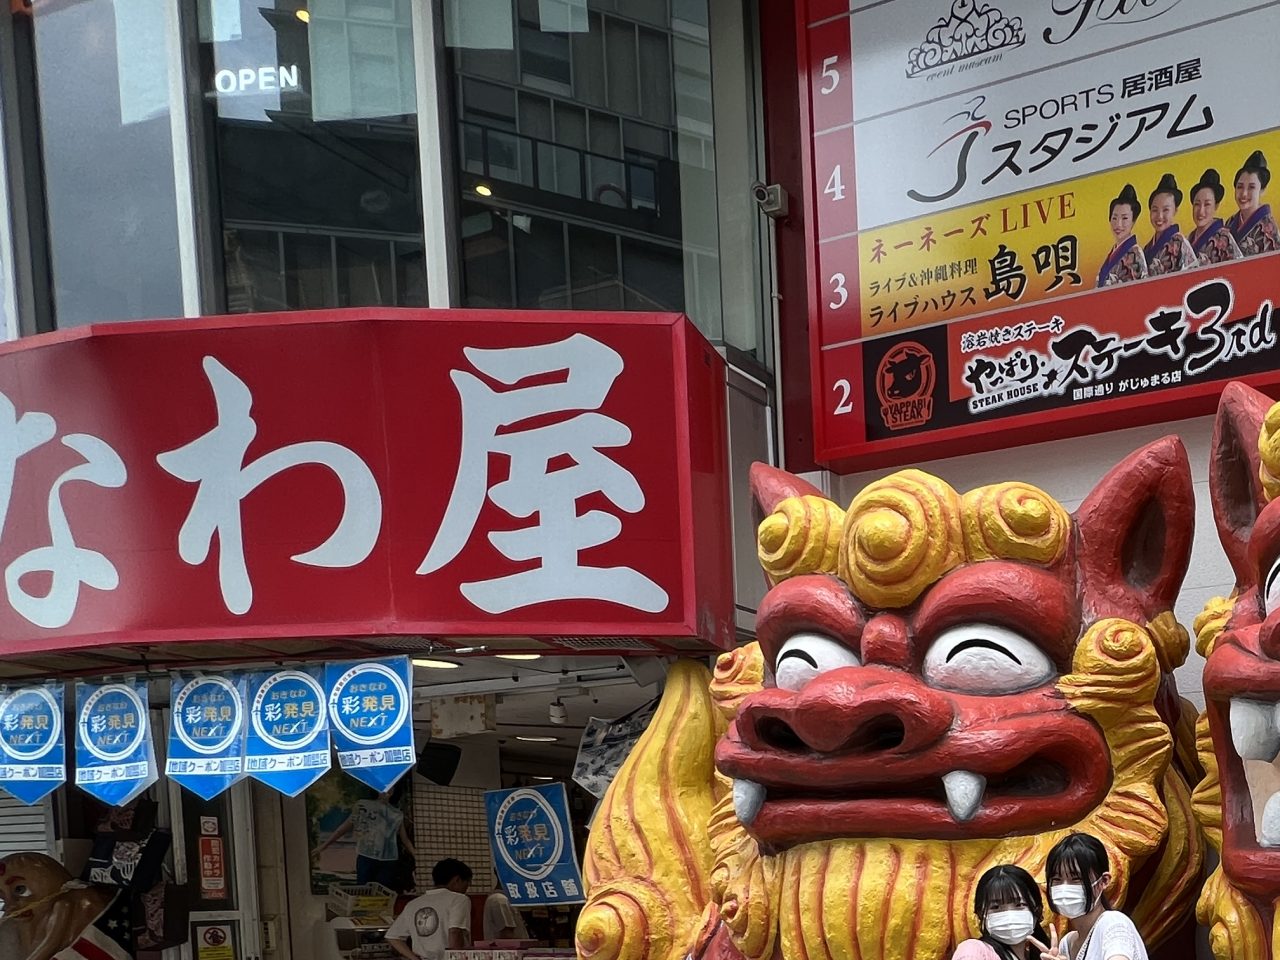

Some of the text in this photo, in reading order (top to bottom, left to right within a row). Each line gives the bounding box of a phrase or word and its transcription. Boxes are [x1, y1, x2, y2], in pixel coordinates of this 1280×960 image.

[214, 64, 298, 94] OPEN
[819, 55, 841, 95] 5
[1003, 57, 1202, 129] SPORTS 居酒屋
[824, 166, 846, 202] 4
[869, 192, 1076, 264] ネーネーズ LIVE
[983, 234, 1083, 301] 島唄
[828, 272, 849, 310] 3
[869, 286, 977, 328] ライブハウス
[961, 316, 1065, 352] 溶岩焼きステーキ
[832, 378, 853, 416] 2
[972, 383, 1039, 410] STEAK HOUSE
[1072, 371, 1182, 401] 国際通り がじゅまる店
[888, 399, 926, 414] YAPPARI
[891, 408, 923, 424] STEAK
[185, 705, 232, 724] 彩発見
[264, 701, 315, 722] 彩発見
[342, 695, 396, 715] 彩発見
[91, 713, 136, 733] 彩発見
[272, 720, 308, 735] NEXT
[349, 713, 388, 728] NEXT
[504, 823, 550, 846] 彩発見
